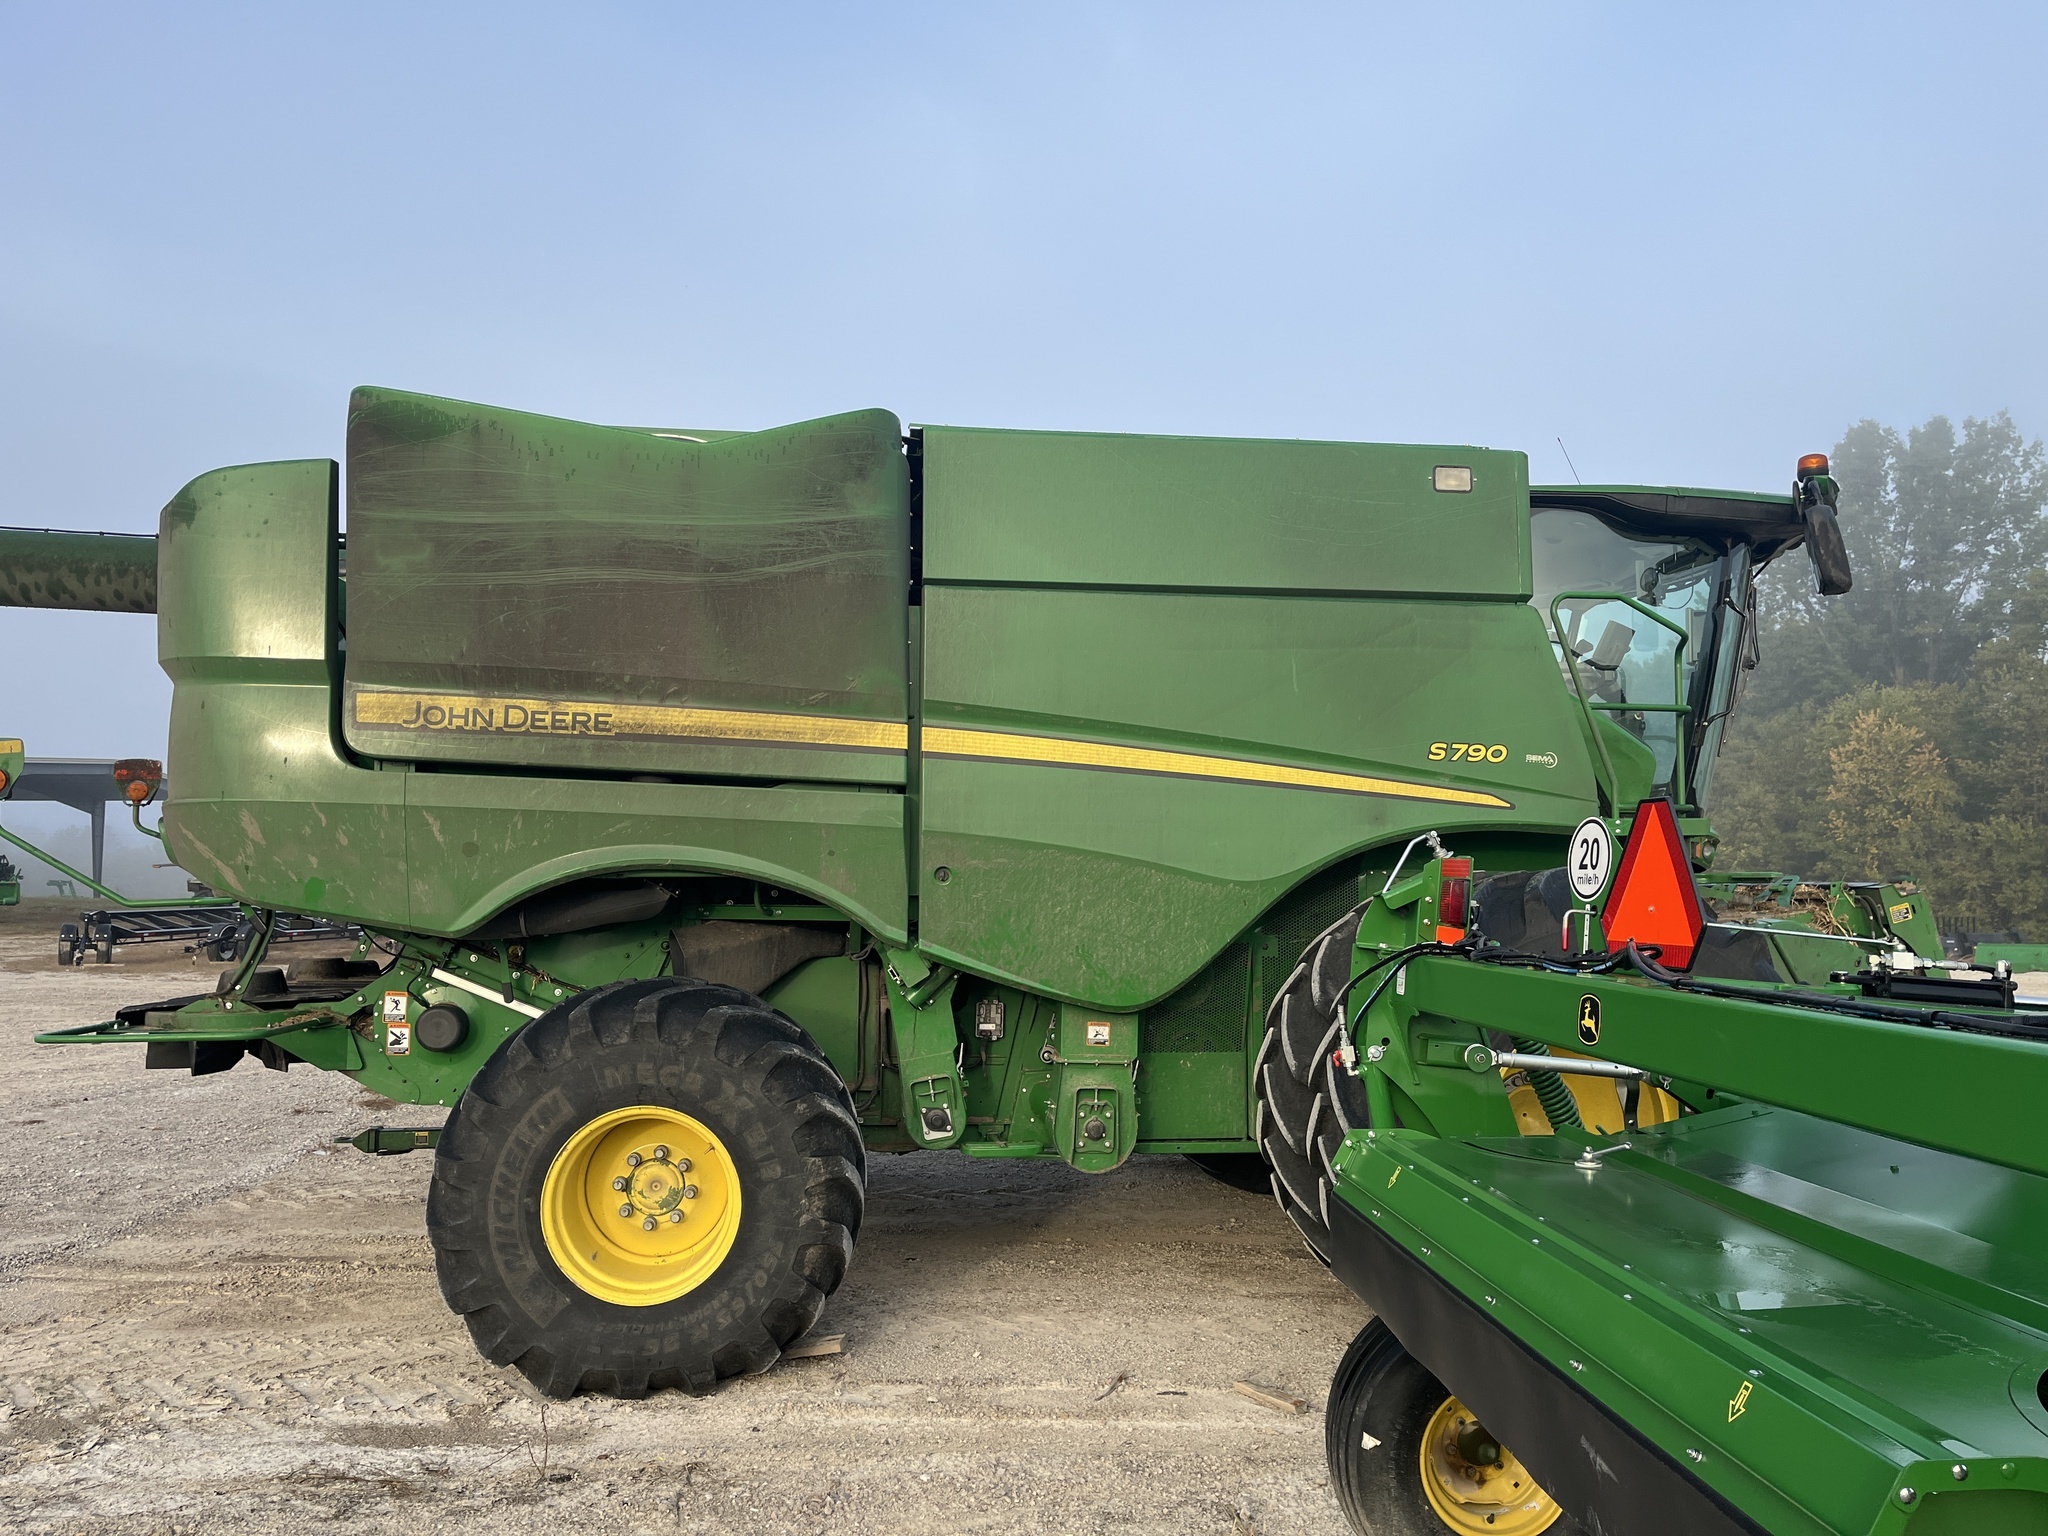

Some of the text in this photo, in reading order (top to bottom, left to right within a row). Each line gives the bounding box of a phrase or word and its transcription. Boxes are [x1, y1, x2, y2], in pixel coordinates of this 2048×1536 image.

[403, 701, 613, 732] JOHN DEERE
[1428, 742, 1508, 763] S790
[1579, 837, 1600, 870] 20
[1577, 874, 1599, 885] mile/h
[494, 1094, 562, 1274] MICHELIN
